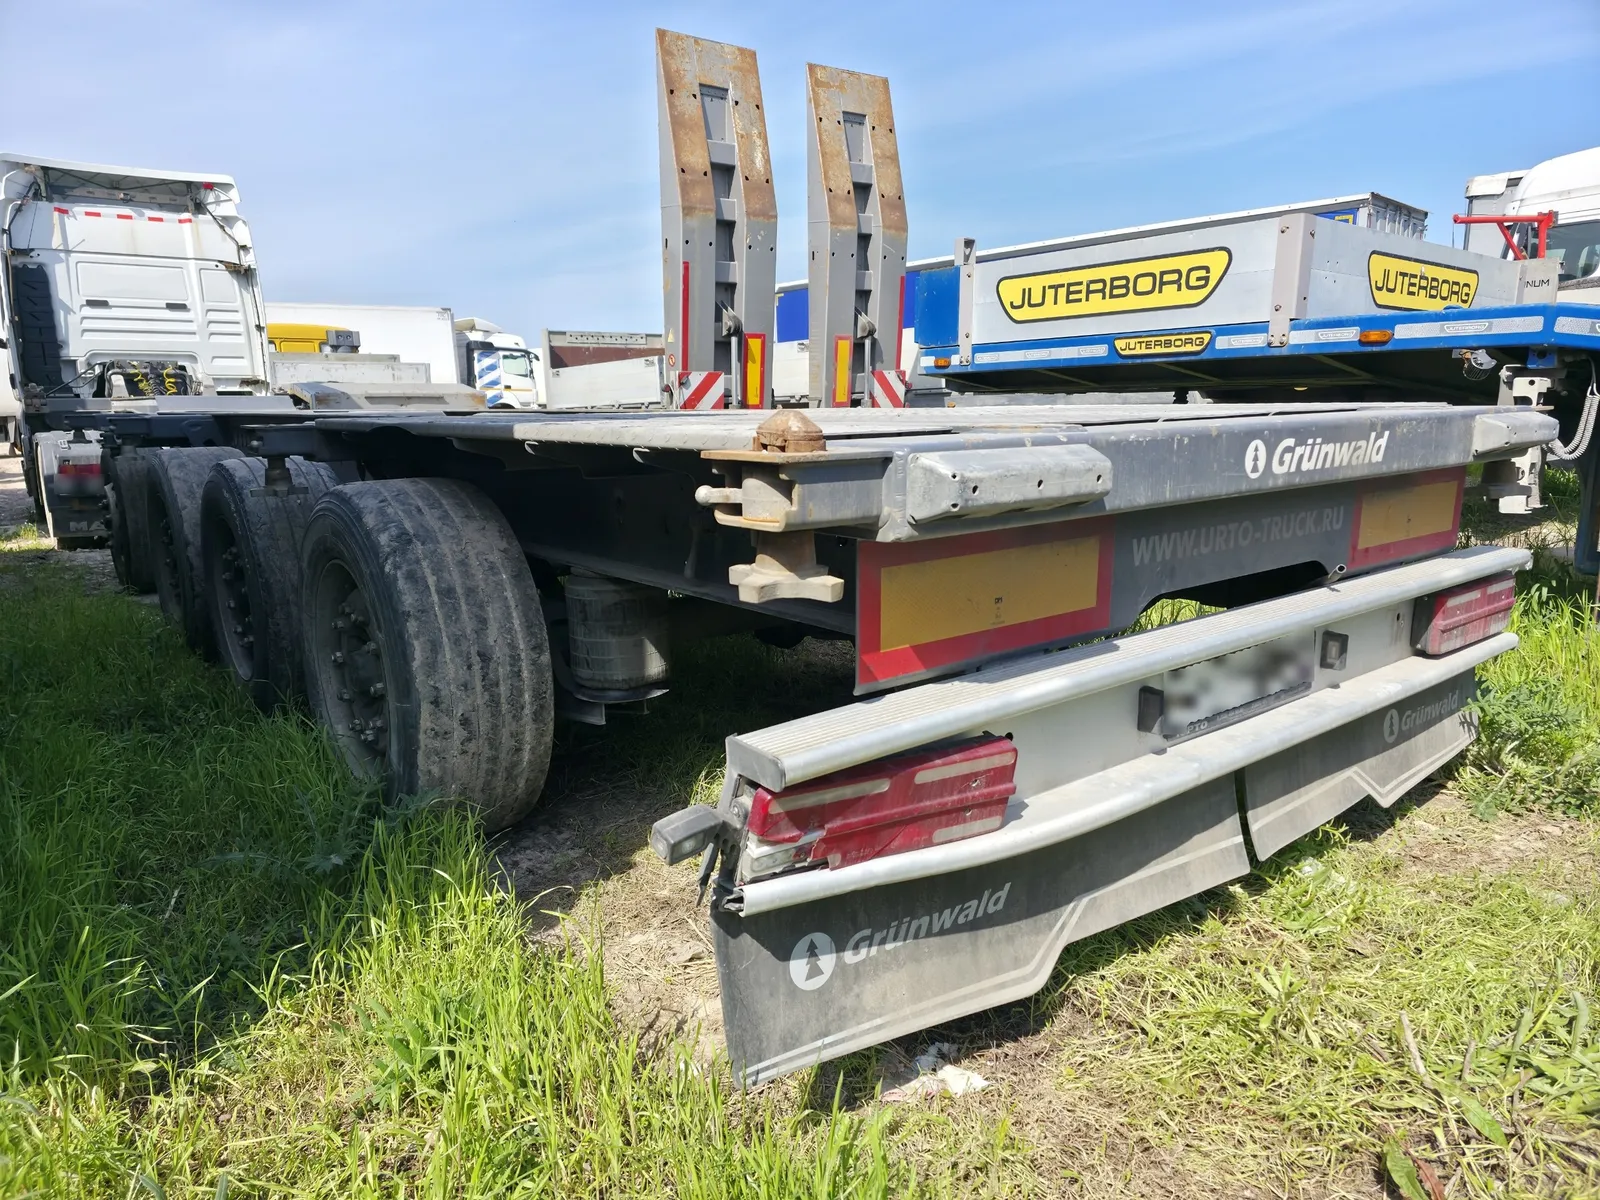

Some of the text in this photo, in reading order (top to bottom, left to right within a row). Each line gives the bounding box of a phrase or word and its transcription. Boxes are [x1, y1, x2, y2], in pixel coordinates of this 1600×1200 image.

[1010, 265, 1211, 310] JUTERBORG
[1375, 269, 1471, 304] JUTERBORG
[1119, 337, 1206, 351] JUTERBORG
[1272, 431, 1390, 475] Grünwald
[70, 521, 107, 531] MA
[1132, 506, 1345, 566] WWW.URTO-TRUCK.RU
[1401, 689, 1459, 731] Grünwald
[844, 882, 1012, 965] Grünwald
